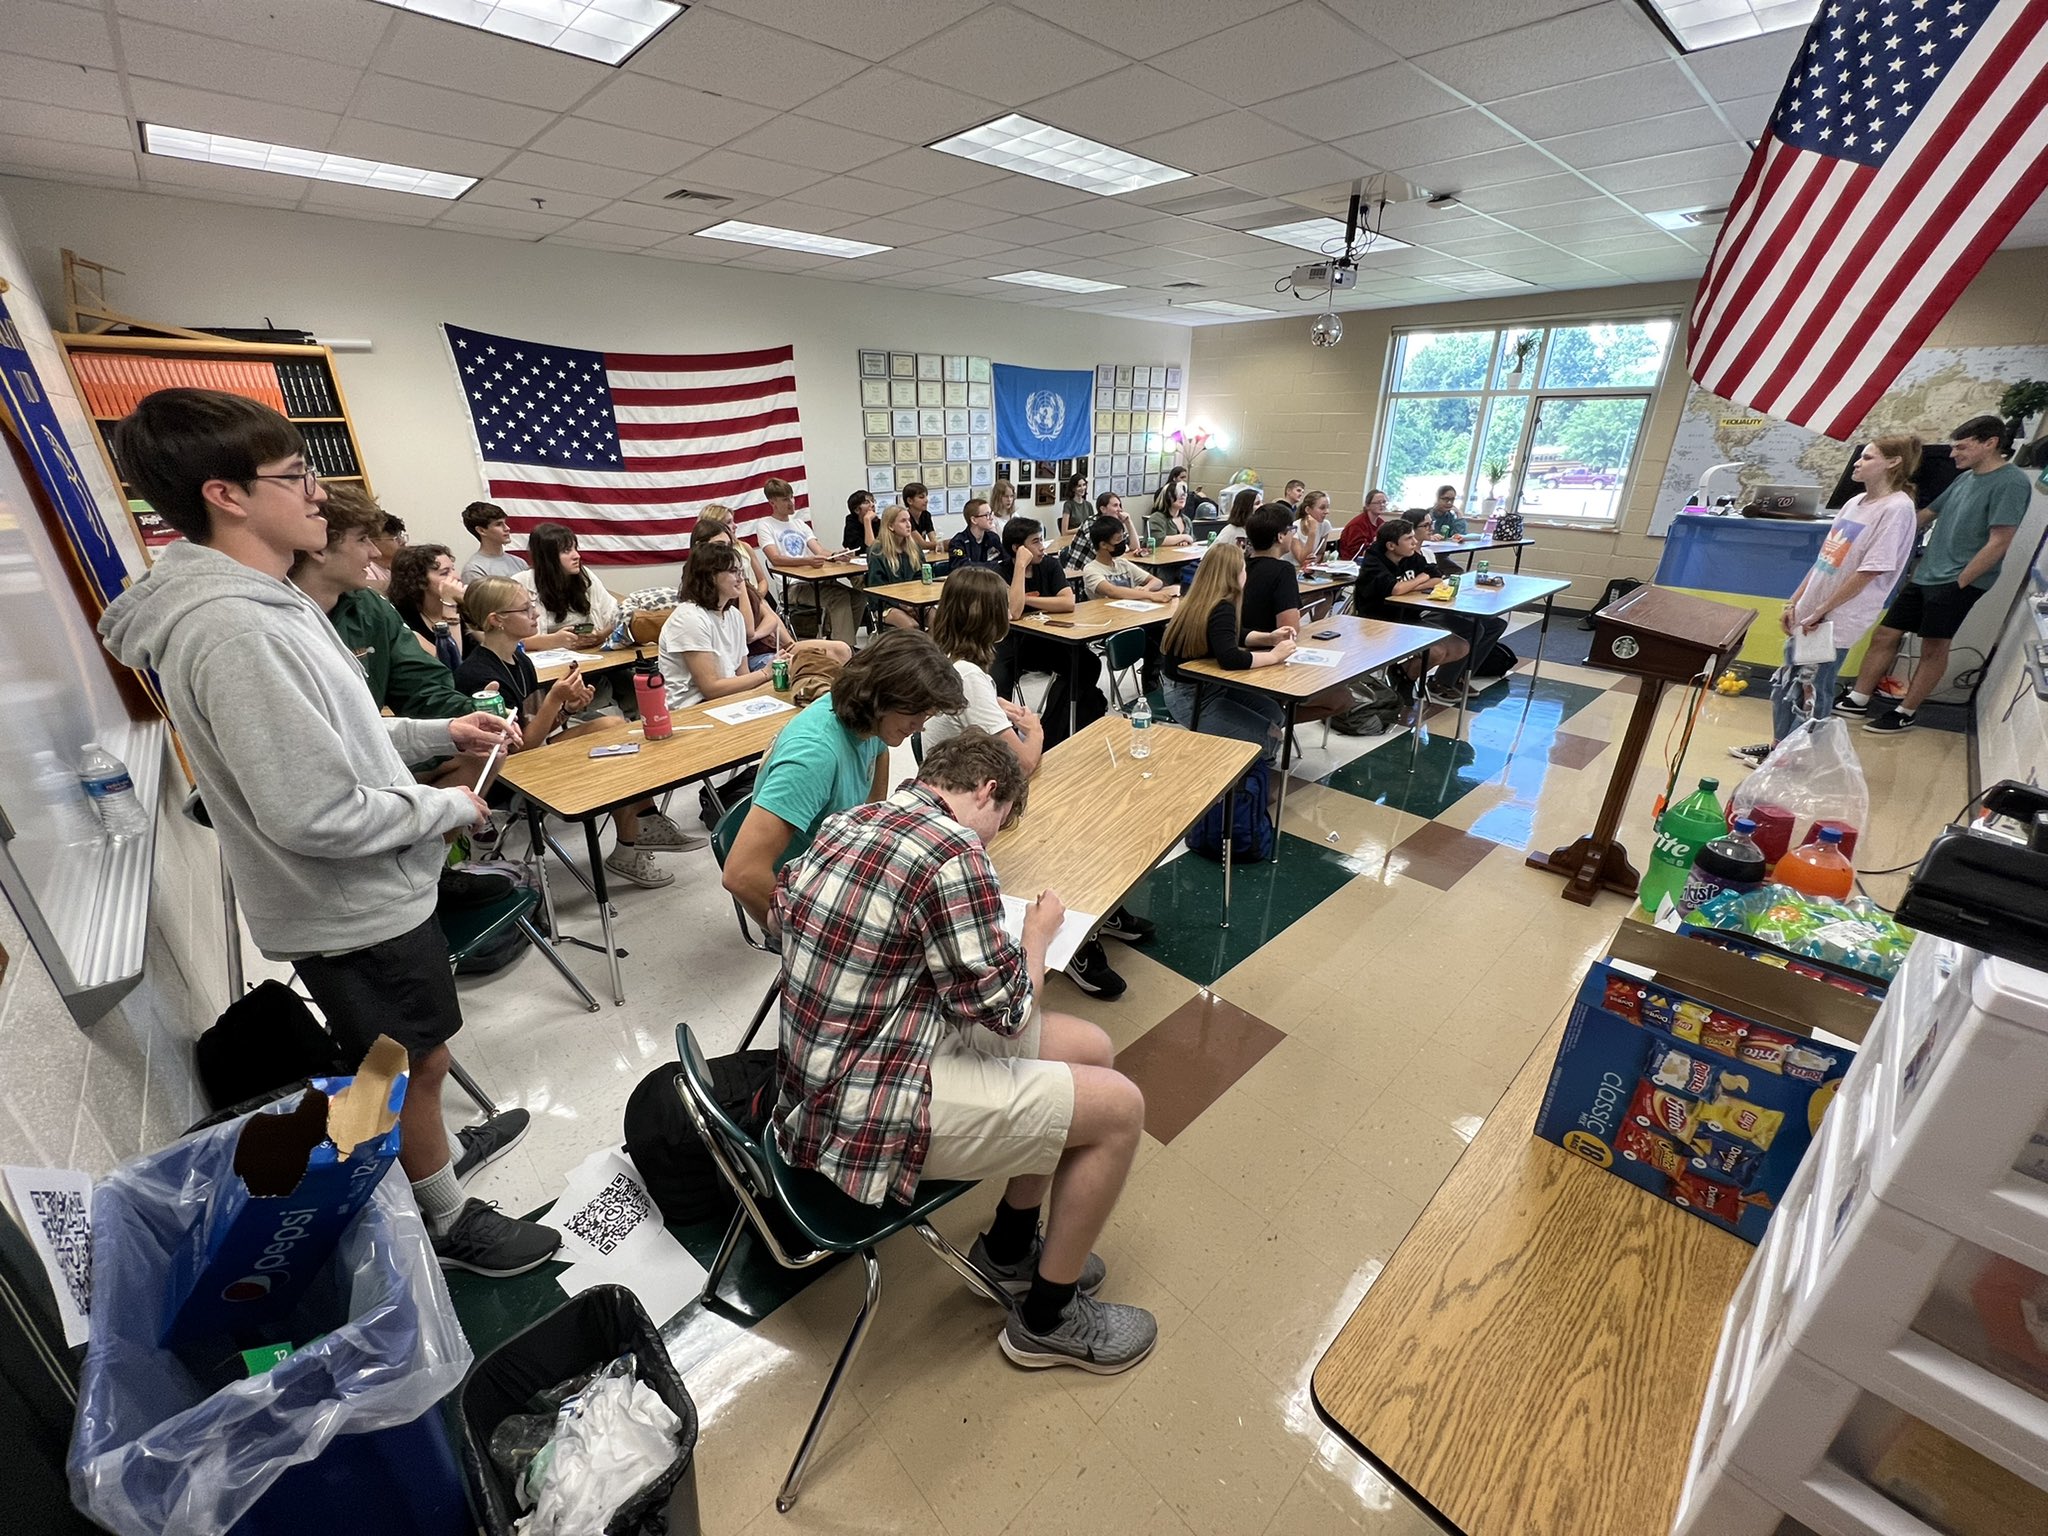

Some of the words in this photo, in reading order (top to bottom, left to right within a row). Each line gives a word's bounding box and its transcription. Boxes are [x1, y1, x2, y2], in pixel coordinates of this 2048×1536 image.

[1586, 1072, 1626, 1135] classic
[1665, 1096, 1685, 1132] Fritos
[1579, 1138, 1605, 1163] 18
[1722, 1146, 1742, 1172] Doritos
[1706, 1185, 1718, 1209] Doritos
[254, 1208, 319, 1270] pepsi
